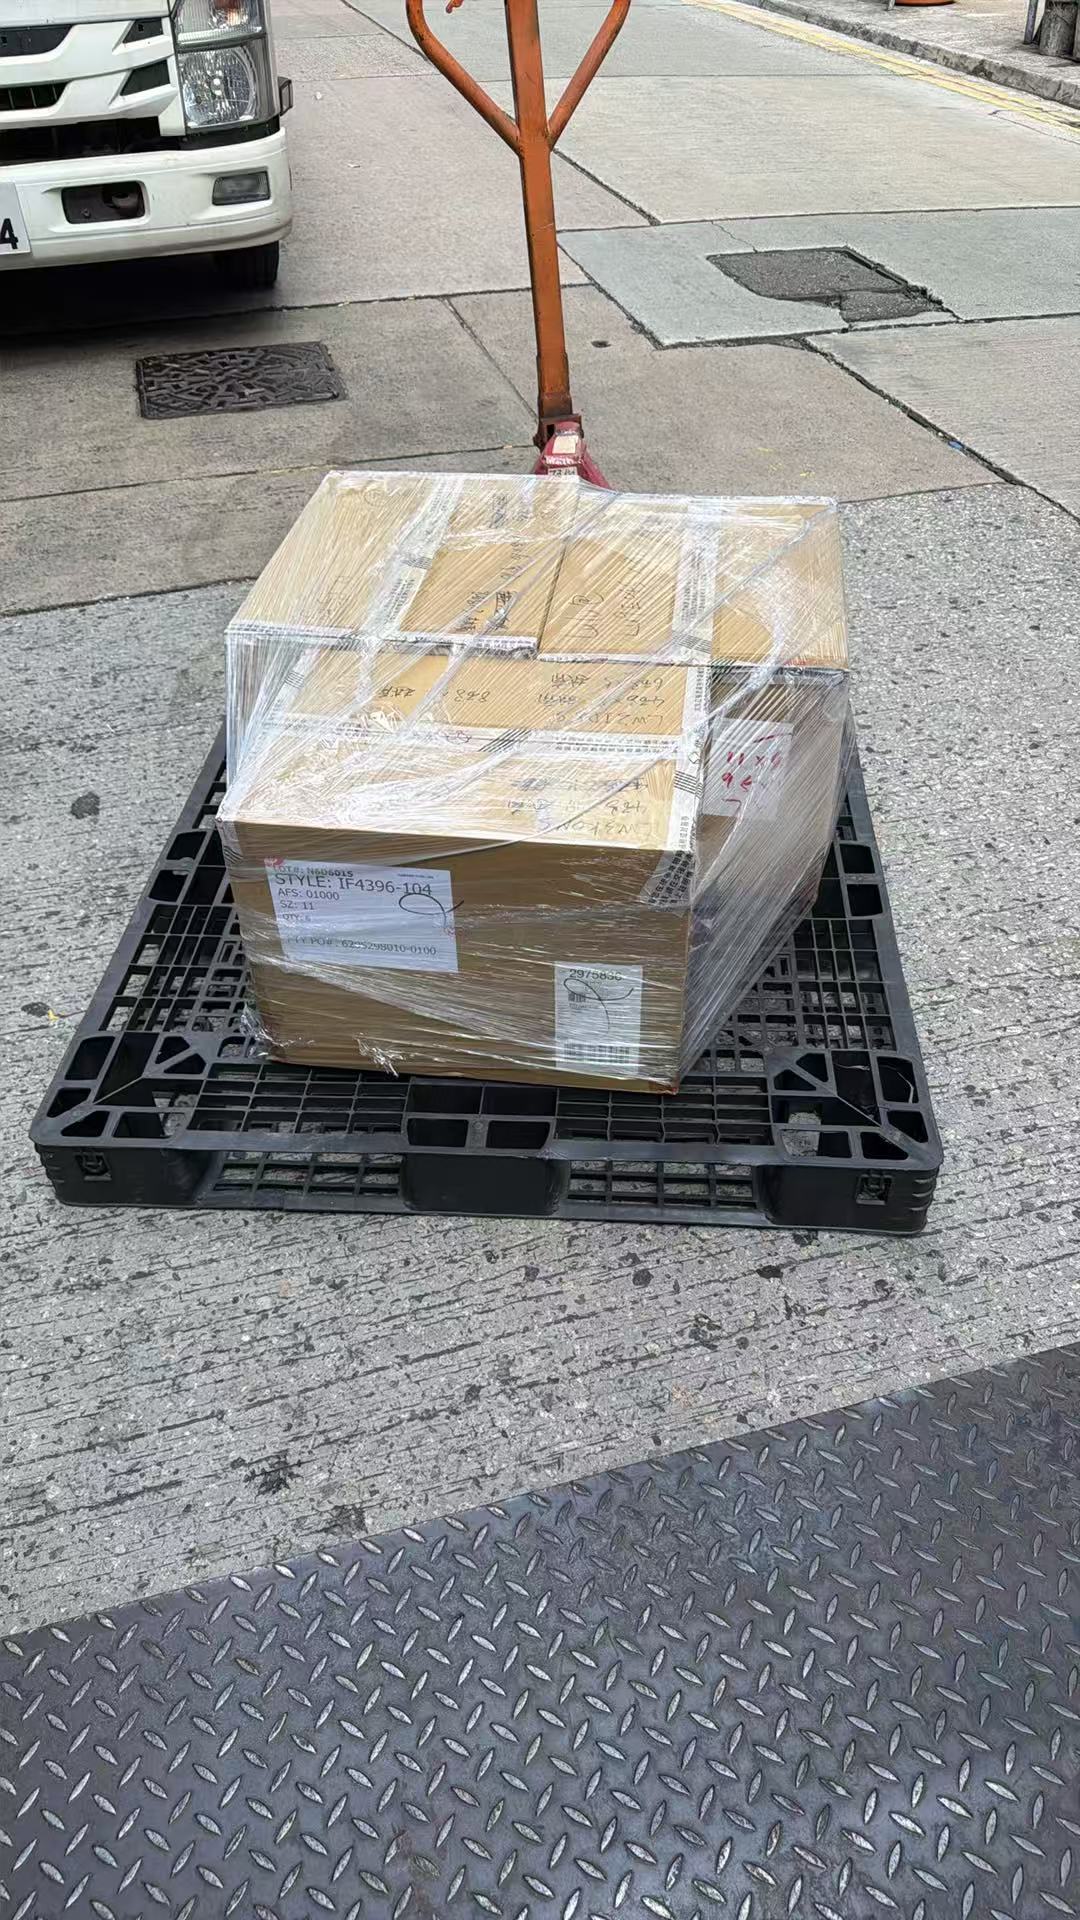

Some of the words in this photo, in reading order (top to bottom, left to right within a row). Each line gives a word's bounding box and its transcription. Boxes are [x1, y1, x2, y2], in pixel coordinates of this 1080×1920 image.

[0, 218, 18, 249] 4
[275, 873, 332, 889] STYLE:
[339, 878, 433, 896] IF4396-104
[278, 889, 302, 898] AFS:
[306, 890, 340, 901] 01000
[280, 900, 298, 909] SZ:
[302, 901, 314, 910] 11
